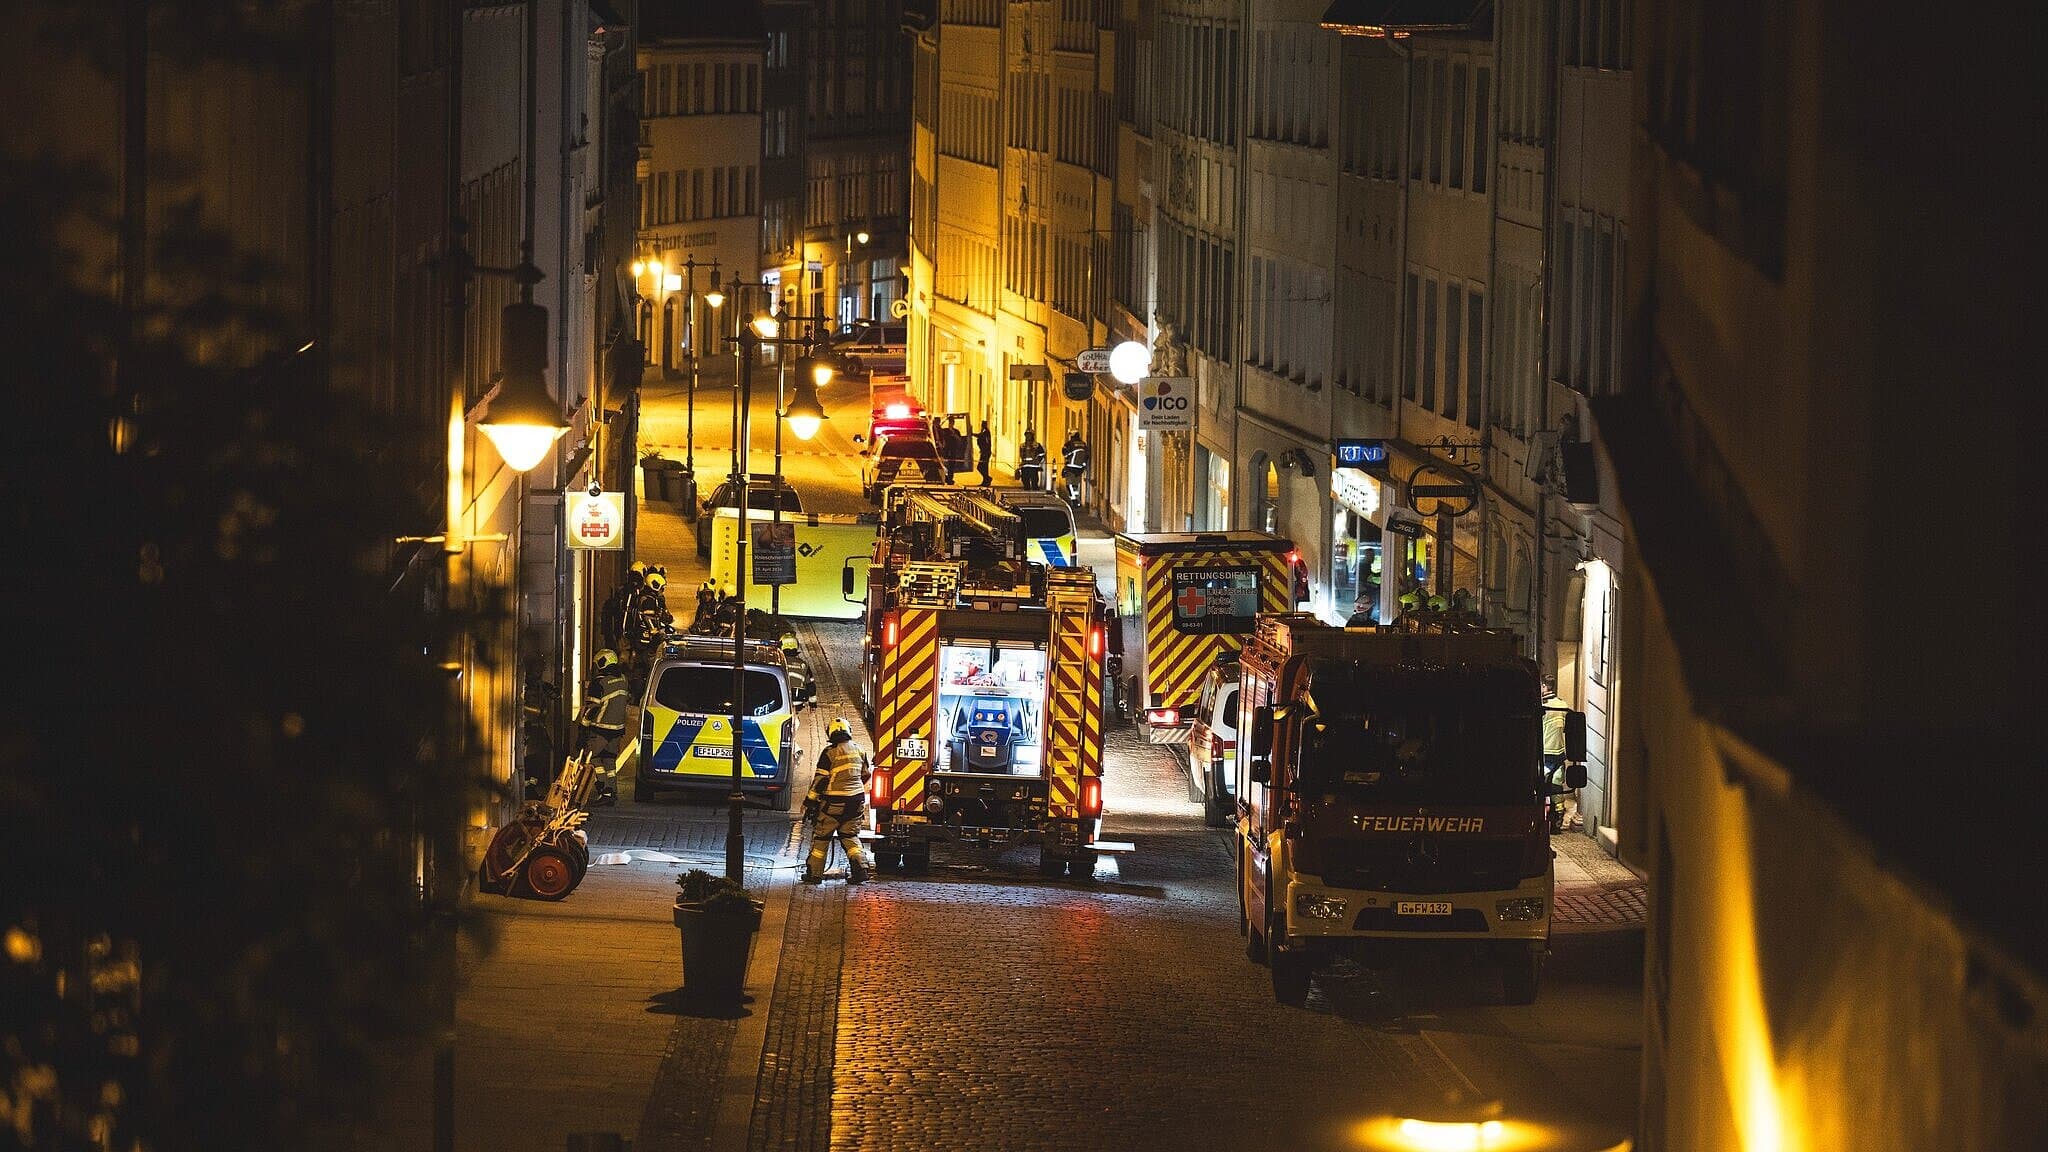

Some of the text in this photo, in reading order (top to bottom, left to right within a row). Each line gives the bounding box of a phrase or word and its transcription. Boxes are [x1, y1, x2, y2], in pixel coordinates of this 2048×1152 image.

[1339, 446, 1386, 461] KIND
[1176, 571, 1258, 581] RETTUNGSDIENST
[899, 749, 909, 757] FW
[1362, 817, 1484, 832] FEUERWEHR
